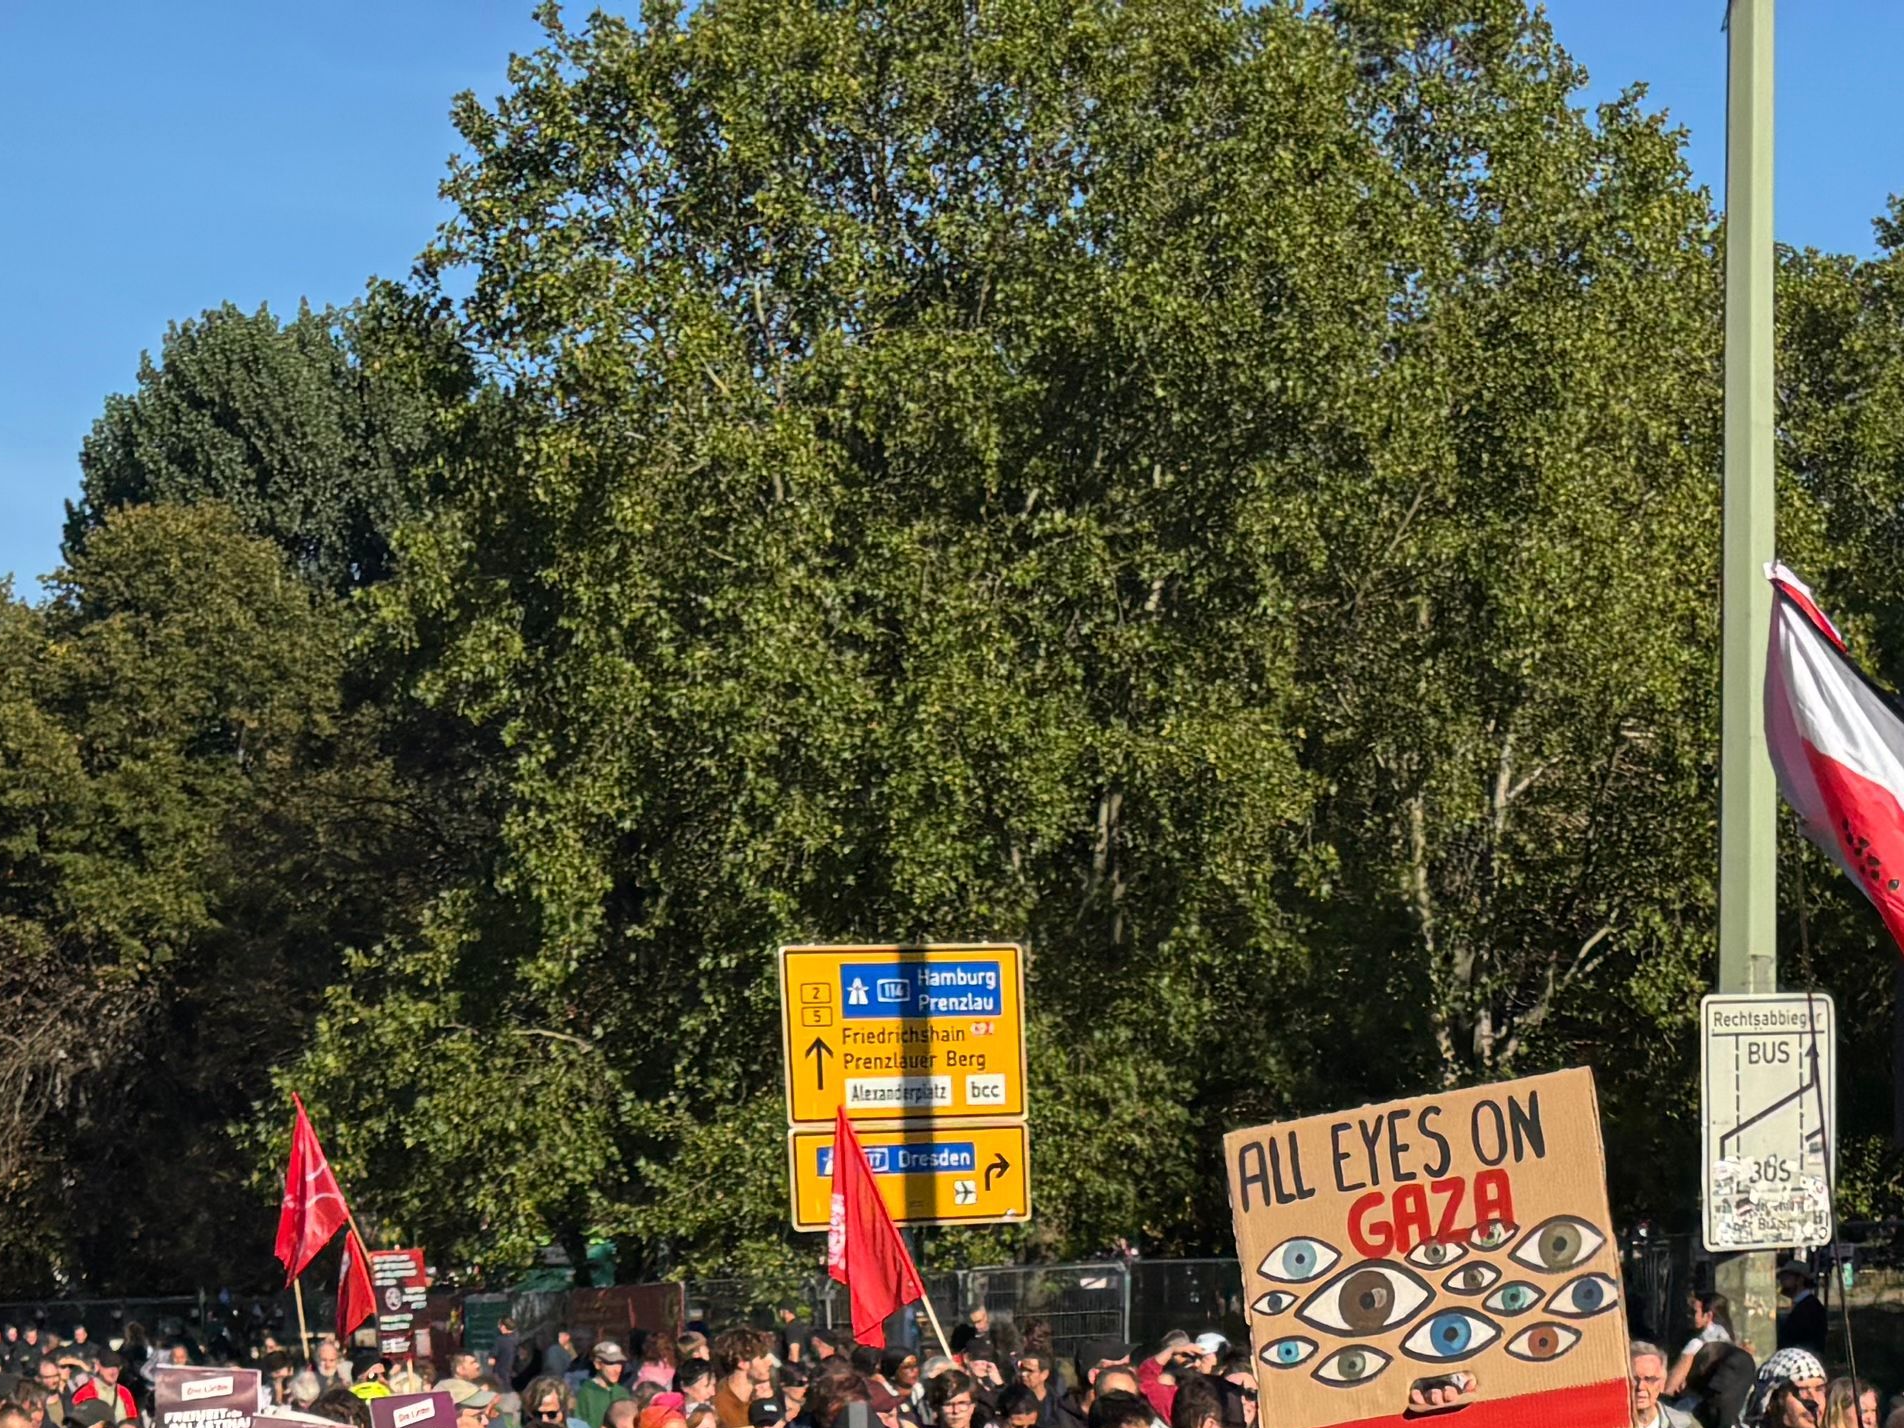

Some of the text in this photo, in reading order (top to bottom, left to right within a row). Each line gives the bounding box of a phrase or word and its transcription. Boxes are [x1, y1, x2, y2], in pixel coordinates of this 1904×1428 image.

[884, 969, 996, 998] 114 Hamburg
[812, 987, 820, 999] 2
[919, 995, 994, 1011] Prenzlau
[813, 1010, 821, 1022] 5
[1713, 1010, 1822, 1028] Rechtsabbiegr
[842, 1026, 965, 1045] Friedrichshain
[844, 1051, 986, 1071] Prenzlauer Berg
[1748, 1041, 1790, 1064] BUS
[851, 1084, 947, 1103] Alexanderplatz
[971, 1081, 999, 1098] bcc
[899, 1151, 970, 1167] Dresden
[1239, 1090, 1545, 1213] ALL EYES ON
[1347, 1168, 1515, 1259] GAZA
[164, 1408, 228, 1424] FREIHEIT
